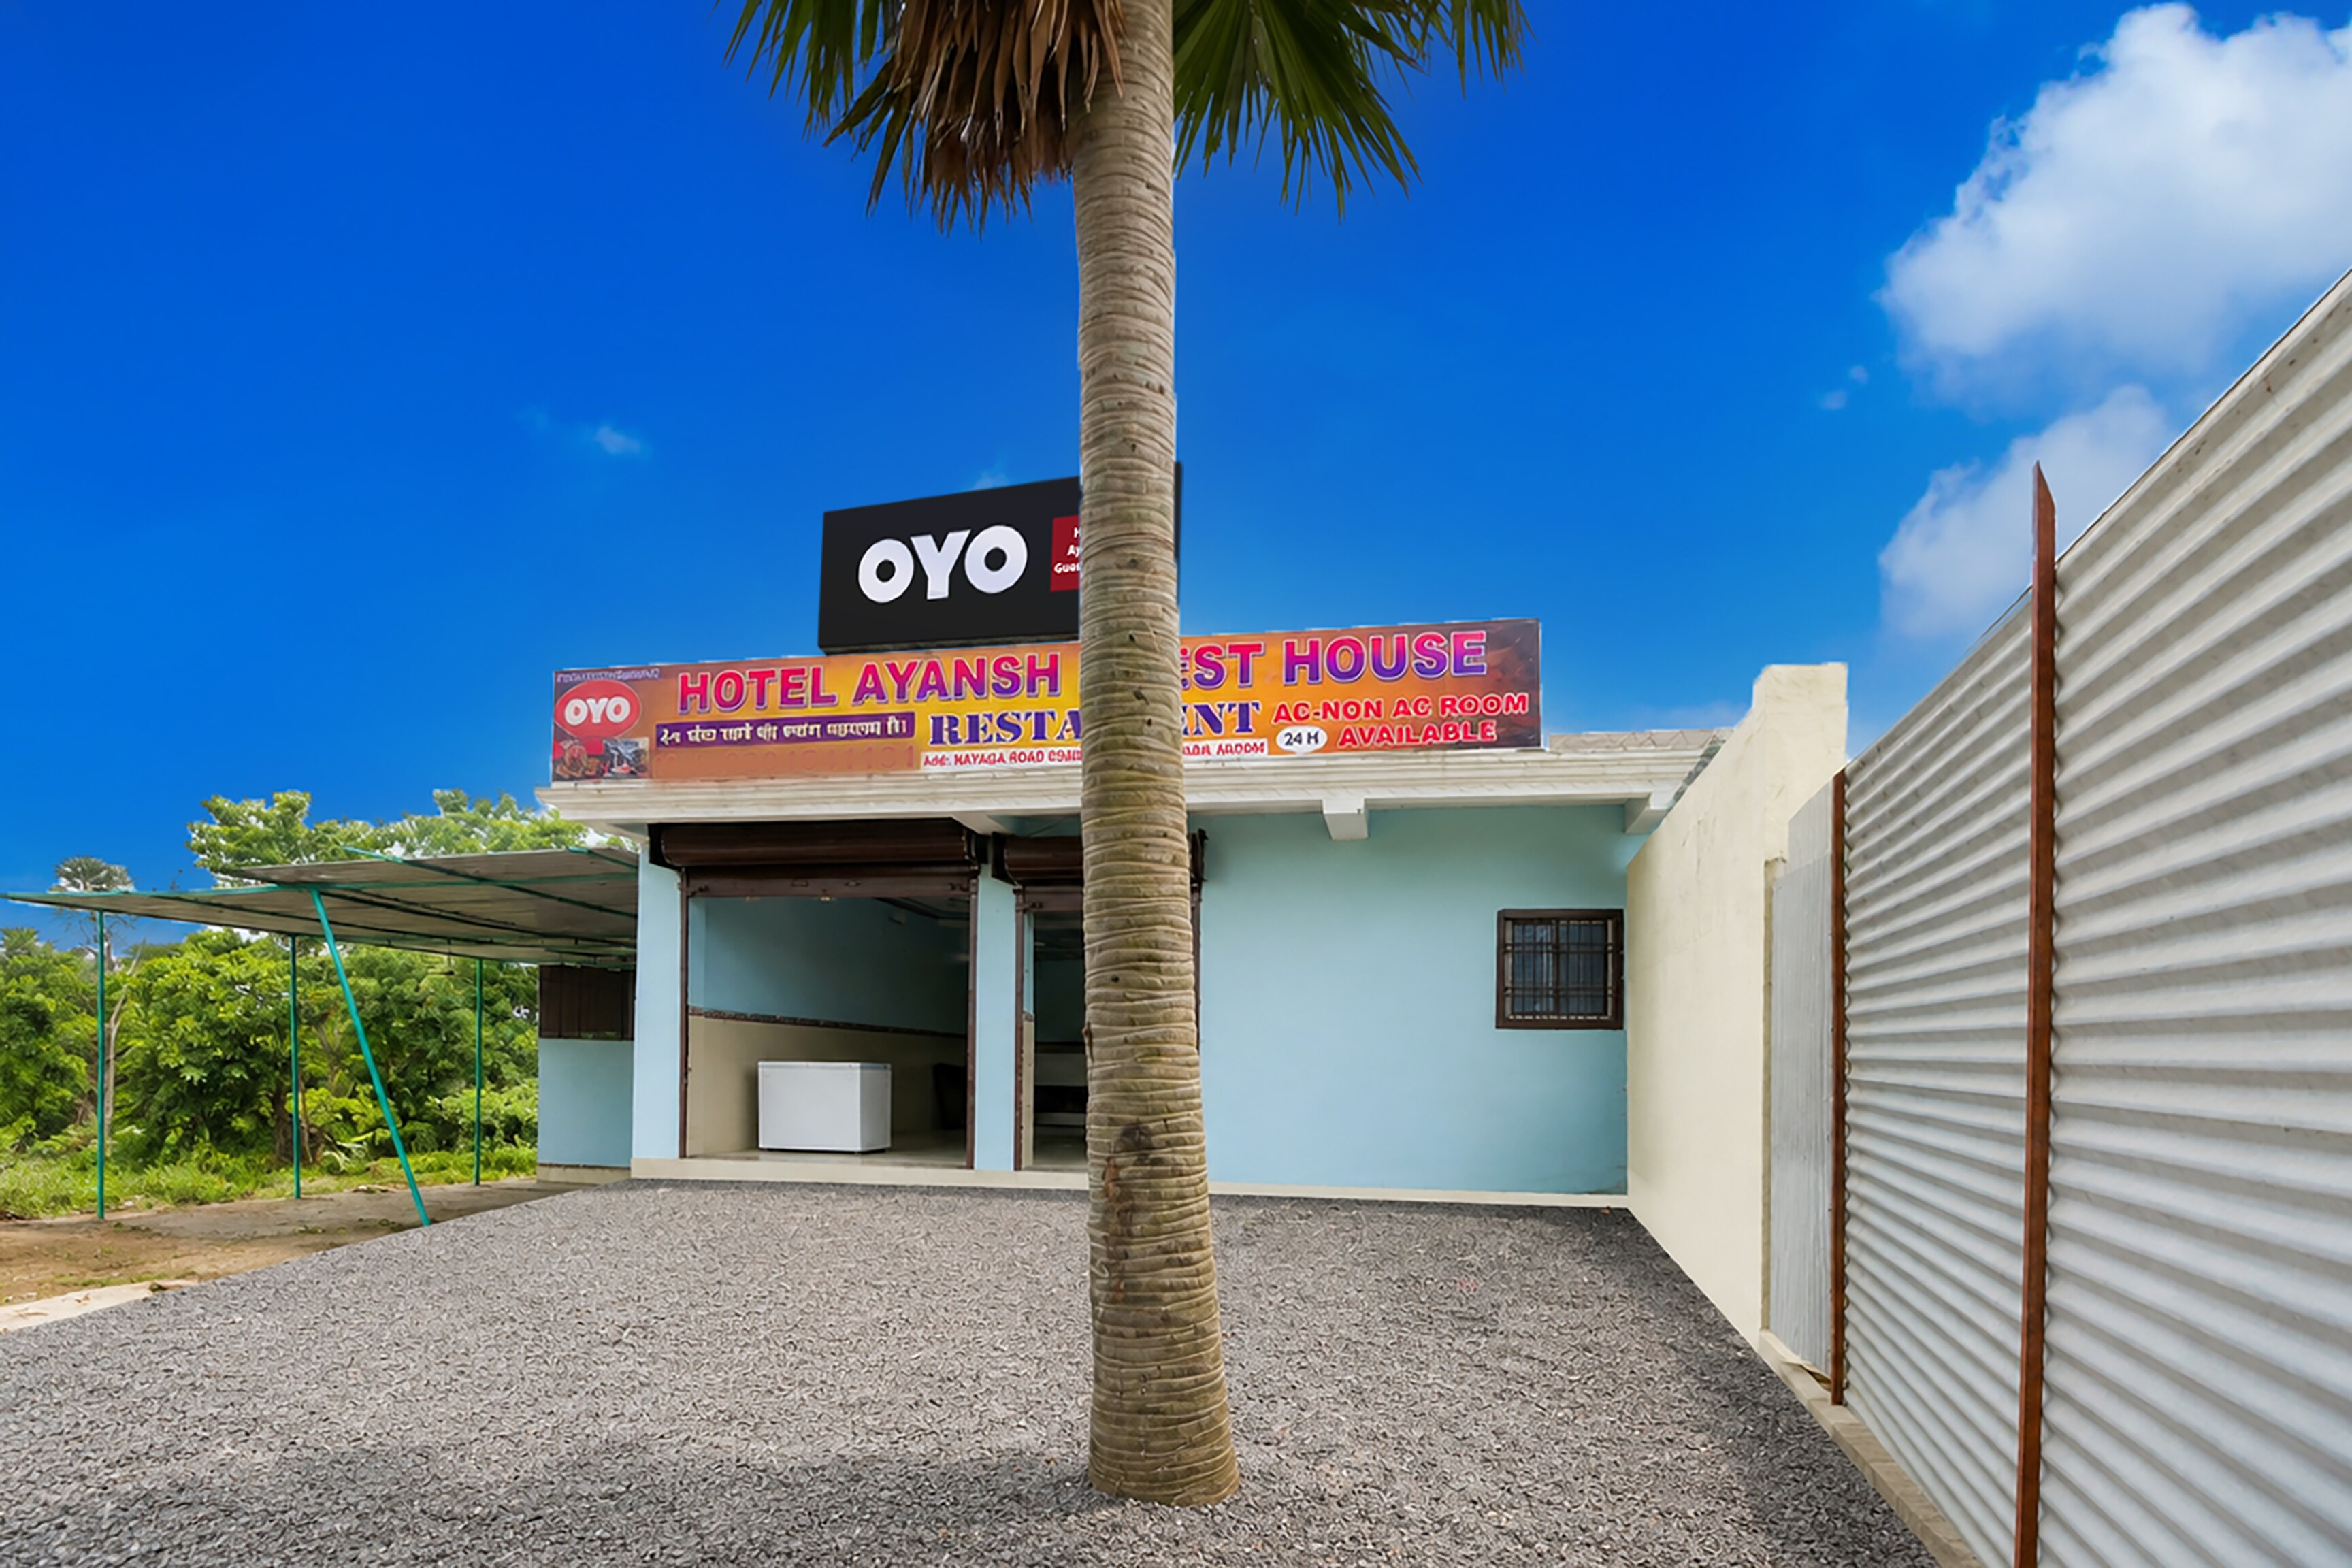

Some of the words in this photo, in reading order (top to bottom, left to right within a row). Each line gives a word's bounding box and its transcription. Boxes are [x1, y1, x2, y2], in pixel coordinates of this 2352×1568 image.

[858, 525, 1028, 604] OYO
[678, 666, 838, 715] HOTEL
[851, 652, 1062, 705] AYANSH
[1283, 630, 1488, 686] HOUSE
[564, 696, 630, 725] OYO
[1439, 693, 1529, 717] ROOM
[1284, 732, 1303, 746] 24
[1307, 730, 1320, 745] H
[1337, 719, 1497, 749] AVAILABLE
[1009, 749, 1045, 763] ROAD
